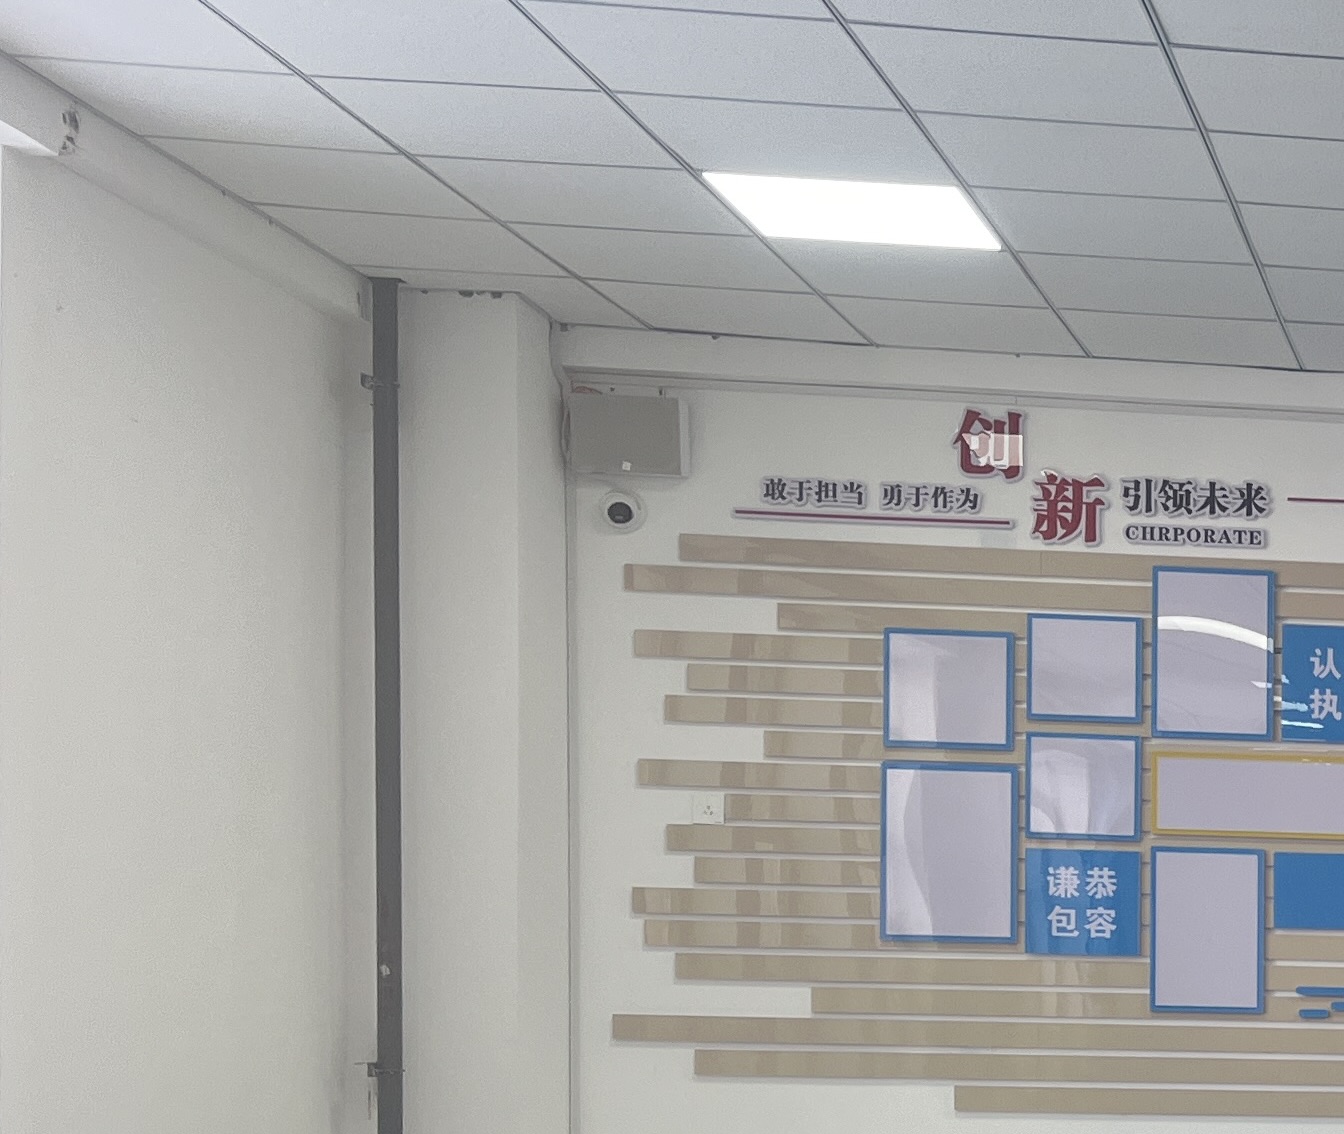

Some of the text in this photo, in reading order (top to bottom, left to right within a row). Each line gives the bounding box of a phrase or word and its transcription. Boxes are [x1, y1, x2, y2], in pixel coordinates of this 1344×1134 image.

[762, 477, 980, 511] 敢于担当 勇于作为
[1122, 478, 1267, 517] 引领未来
[1125, 525, 1263, 546] CHRPORATE
[1046, 866, 1119, 900] 谦恭
[1046, 905, 1118, 939] 包容
